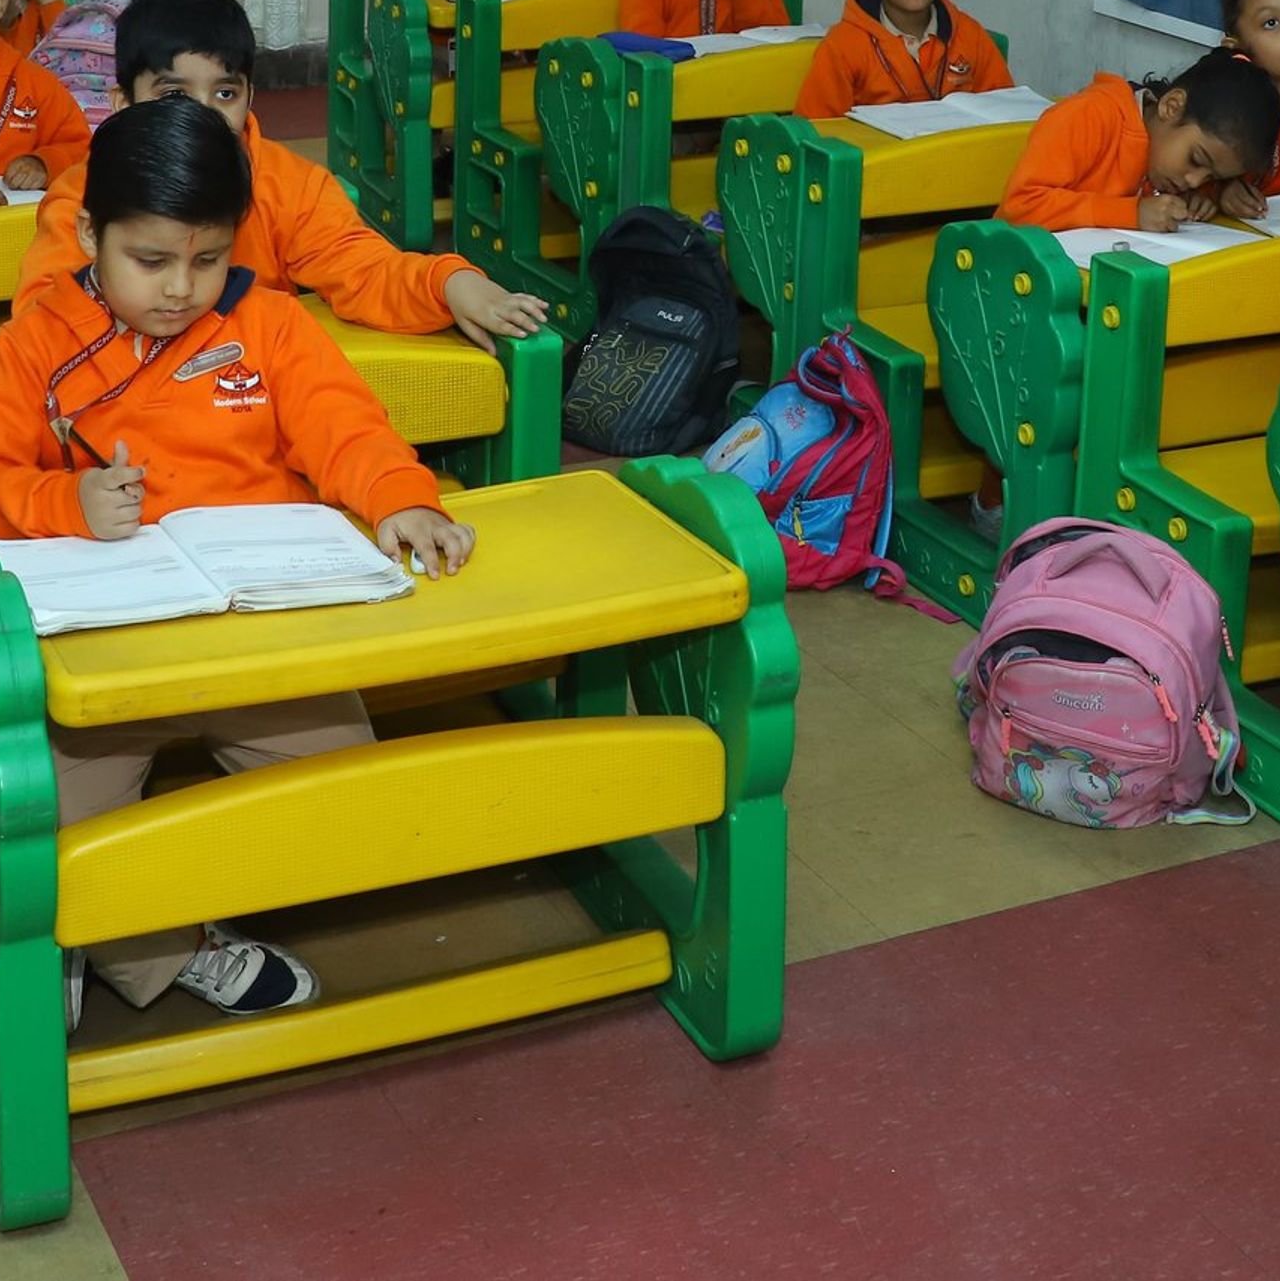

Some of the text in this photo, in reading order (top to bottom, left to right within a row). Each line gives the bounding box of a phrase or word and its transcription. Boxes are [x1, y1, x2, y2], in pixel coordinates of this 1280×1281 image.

[50, 351, 90, 387] MODERN
[213, 396, 267, 407] Modern School
